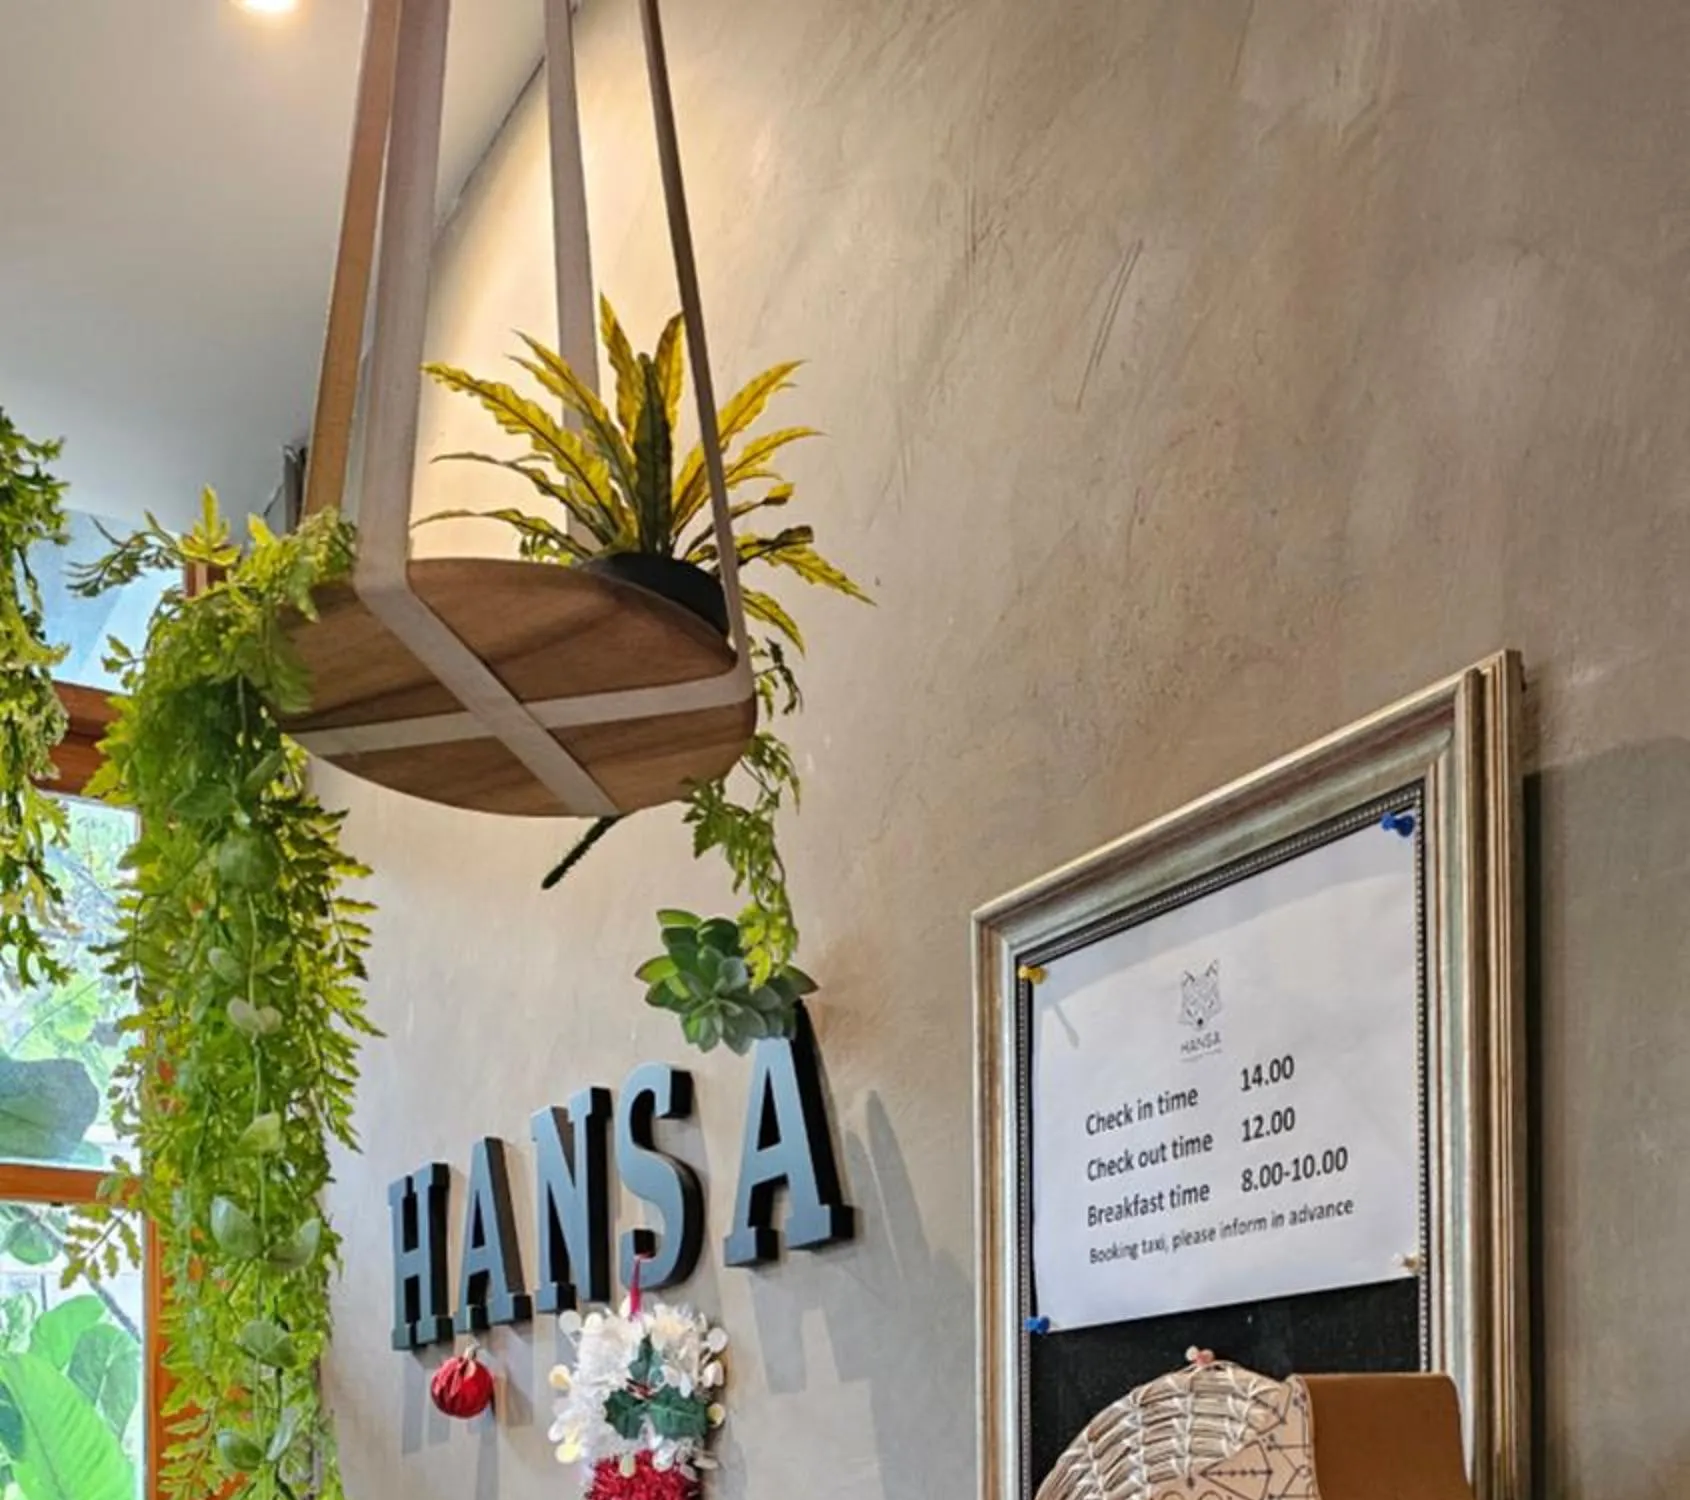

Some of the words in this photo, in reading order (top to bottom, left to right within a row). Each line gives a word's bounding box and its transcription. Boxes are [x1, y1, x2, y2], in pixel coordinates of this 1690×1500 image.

[1180, 1031, 1222, 1054] HANSA
[1085, 1103, 1133, 1136] Check
[1137, 1098, 1153, 1121] in
[1157, 1087, 1199, 1117] time
[1241, 1054, 1295, 1092] 14.00
[388, 1002, 855, 1349] HANSA
[1087, 1148, 1135, 1181] Check
[1137, 1143, 1168, 1168] out
[1171, 1132, 1213, 1160] time
[1242, 1106, 1296, 1142] 12.00
[1087, 1191, 1165, 1227] Breakfast
[1169, 1182, 1210, 1209] time
[1241, 1146, 1349, 1192] 8.00-10.00
[1089, 1241, 1138, 1264] Booking
[1141, 1234, 1169, 1254] taxi,
[1171, 1226, 1217, 1251] please
[1219, 1216, 1268, 1238] inform
[1271, 1210, 1285, 1228] in
[1288, 1198, 1355, 1226] advance
